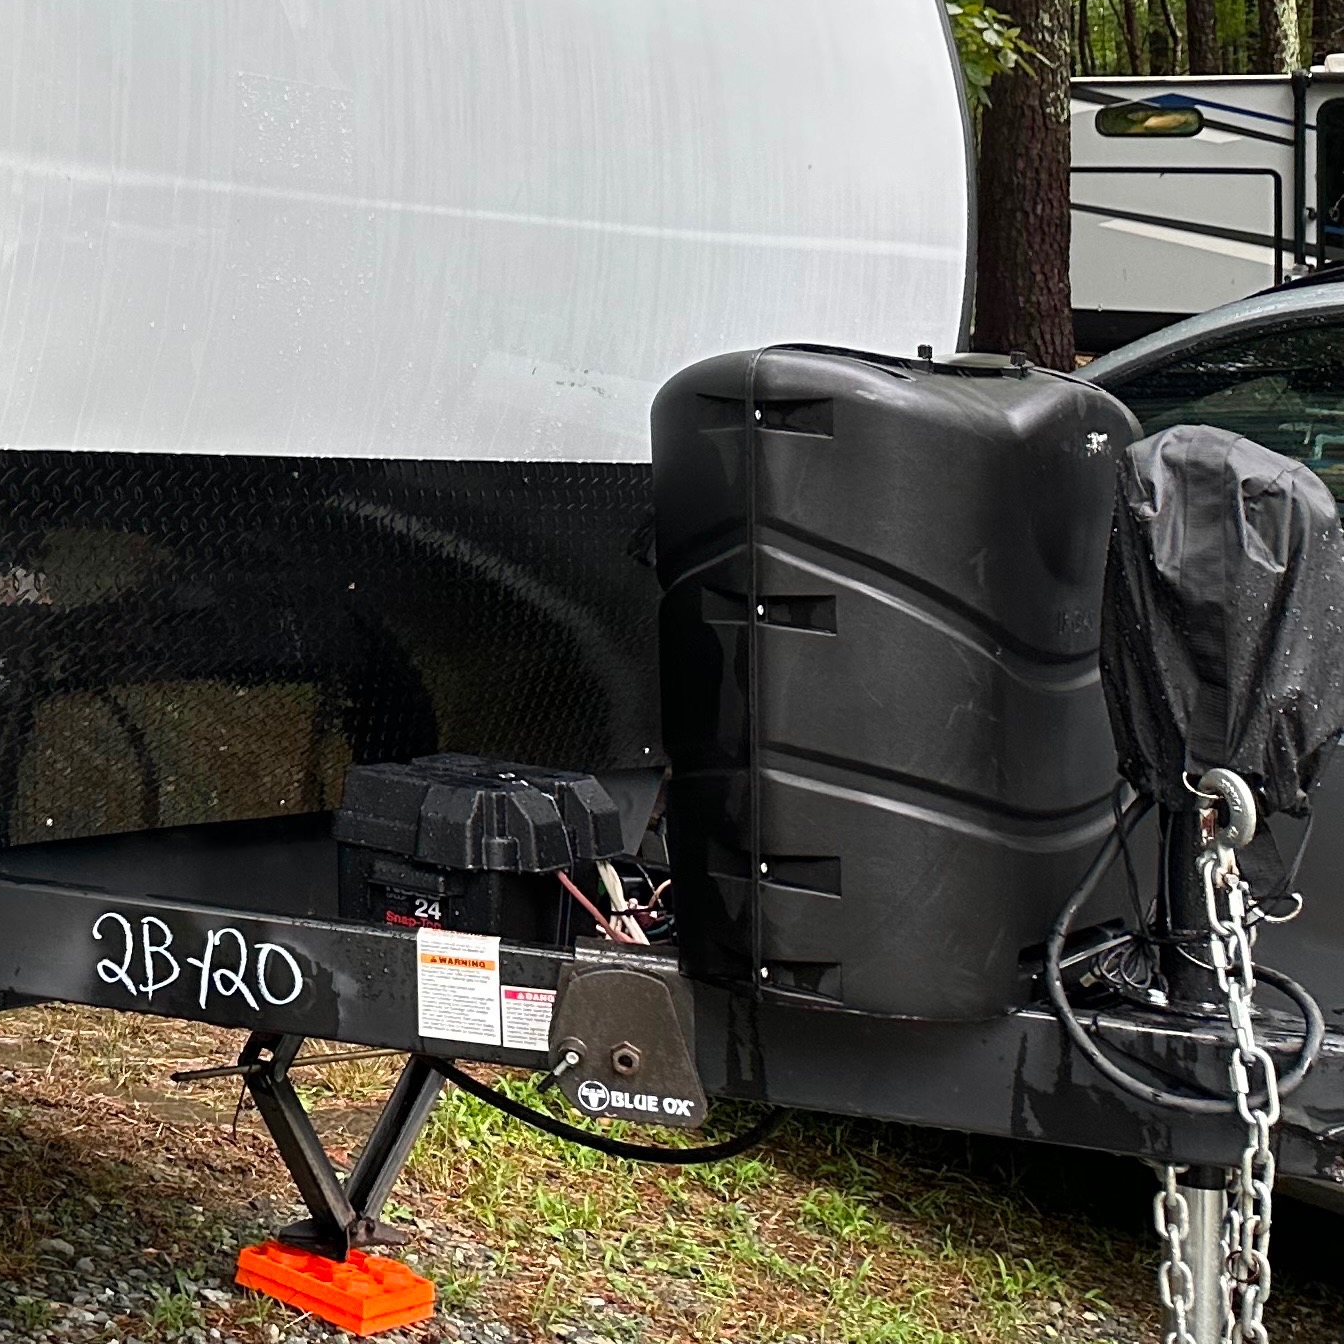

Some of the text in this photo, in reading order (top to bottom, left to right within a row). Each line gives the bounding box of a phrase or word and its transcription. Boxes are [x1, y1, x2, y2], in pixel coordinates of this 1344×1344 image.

[414, 898, 442, 920] 24
[438, 956, 486, 969] WARNING
[610, 1090, 692, 1117] BLUE OX
